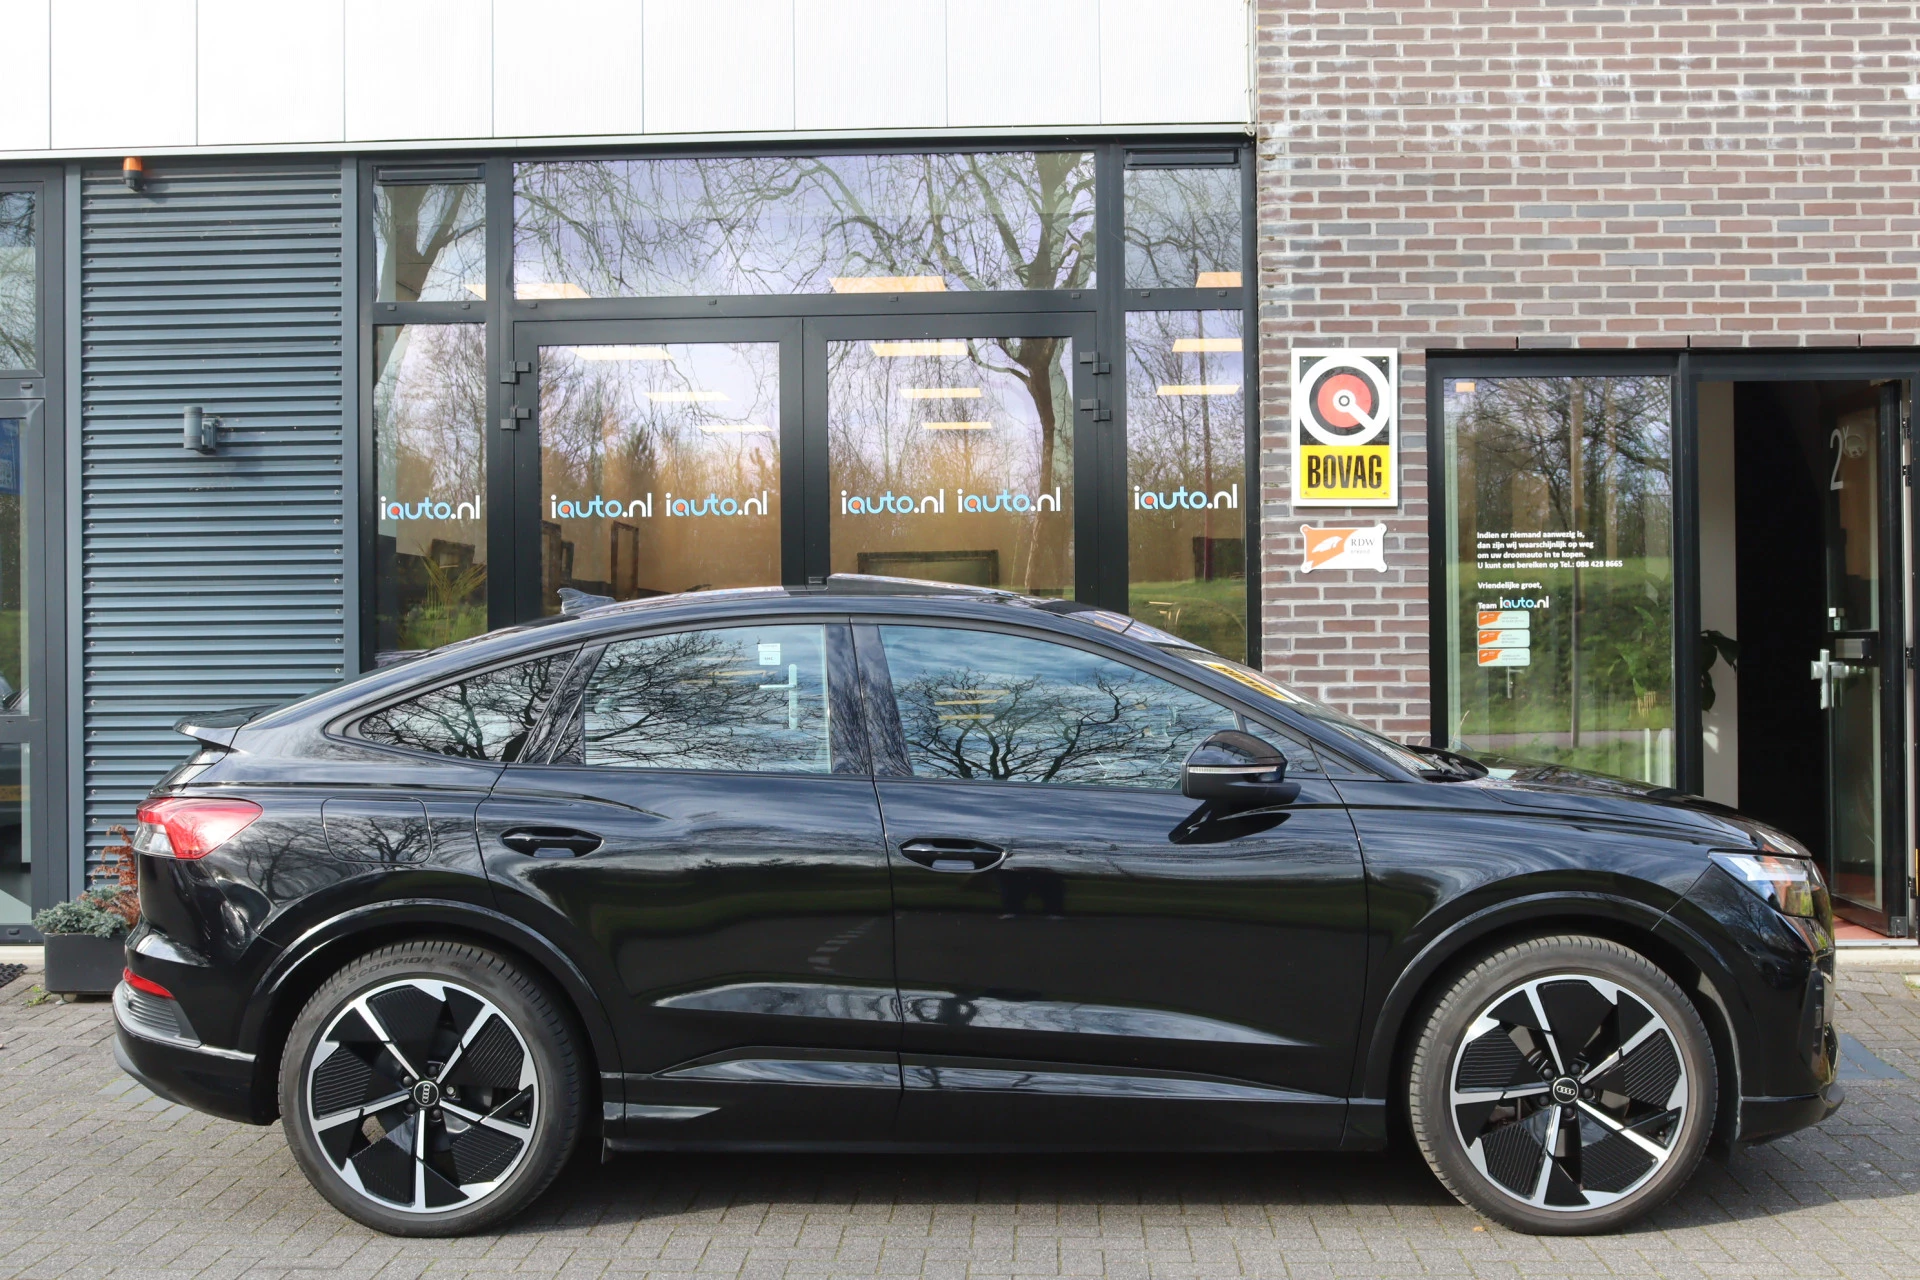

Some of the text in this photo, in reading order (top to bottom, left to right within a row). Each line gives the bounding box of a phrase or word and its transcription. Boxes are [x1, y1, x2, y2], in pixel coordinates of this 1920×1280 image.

[1307, 454, 1382, 489] BOVAG
[380, 496, 481, 520] iauto.nl
[551, 493, 653, 519] iauto.nl
[666, 491, 768, 517] iauto.nl
[841, 489, 945, 515] iauto.nl
[957, 487, 1061, 513] iauto.nl
[1133, 484, 1238, 510] iauto.nl
[1350, 538, 1375, 547] RDW
[1477, 531, 1500, 539] Indien
[1542, 531, 1576, 539] aanwezig
[1577, 530, 1585, 539] is,
[1477, 541, 1491, 549] dan
[1492, 541, 1505, 550] zijn
[1506, 541, 1517, 550] wij
[1518, 540, 1567, 550] waarschijnlijk
[1579, 541, 1594, 549] weg
[1485, 561, 1501, 569] kunt
[1516, 561, 1548, 569] bereiken
[1575, 560, 1590, 568] 088
[1590, 560, 1604, 568] 428
[1605, 560, 1623, 568] 8665
[1503, 551, 1543, 559] droomauto
[1561, 550, 1586, 559] kopen.
[1477, 581, 1542, 590] Vriendelijke groet,
[1499, 595, 1550, 609] iauto.nl
[349, 956, 434, 984] SCORPION
